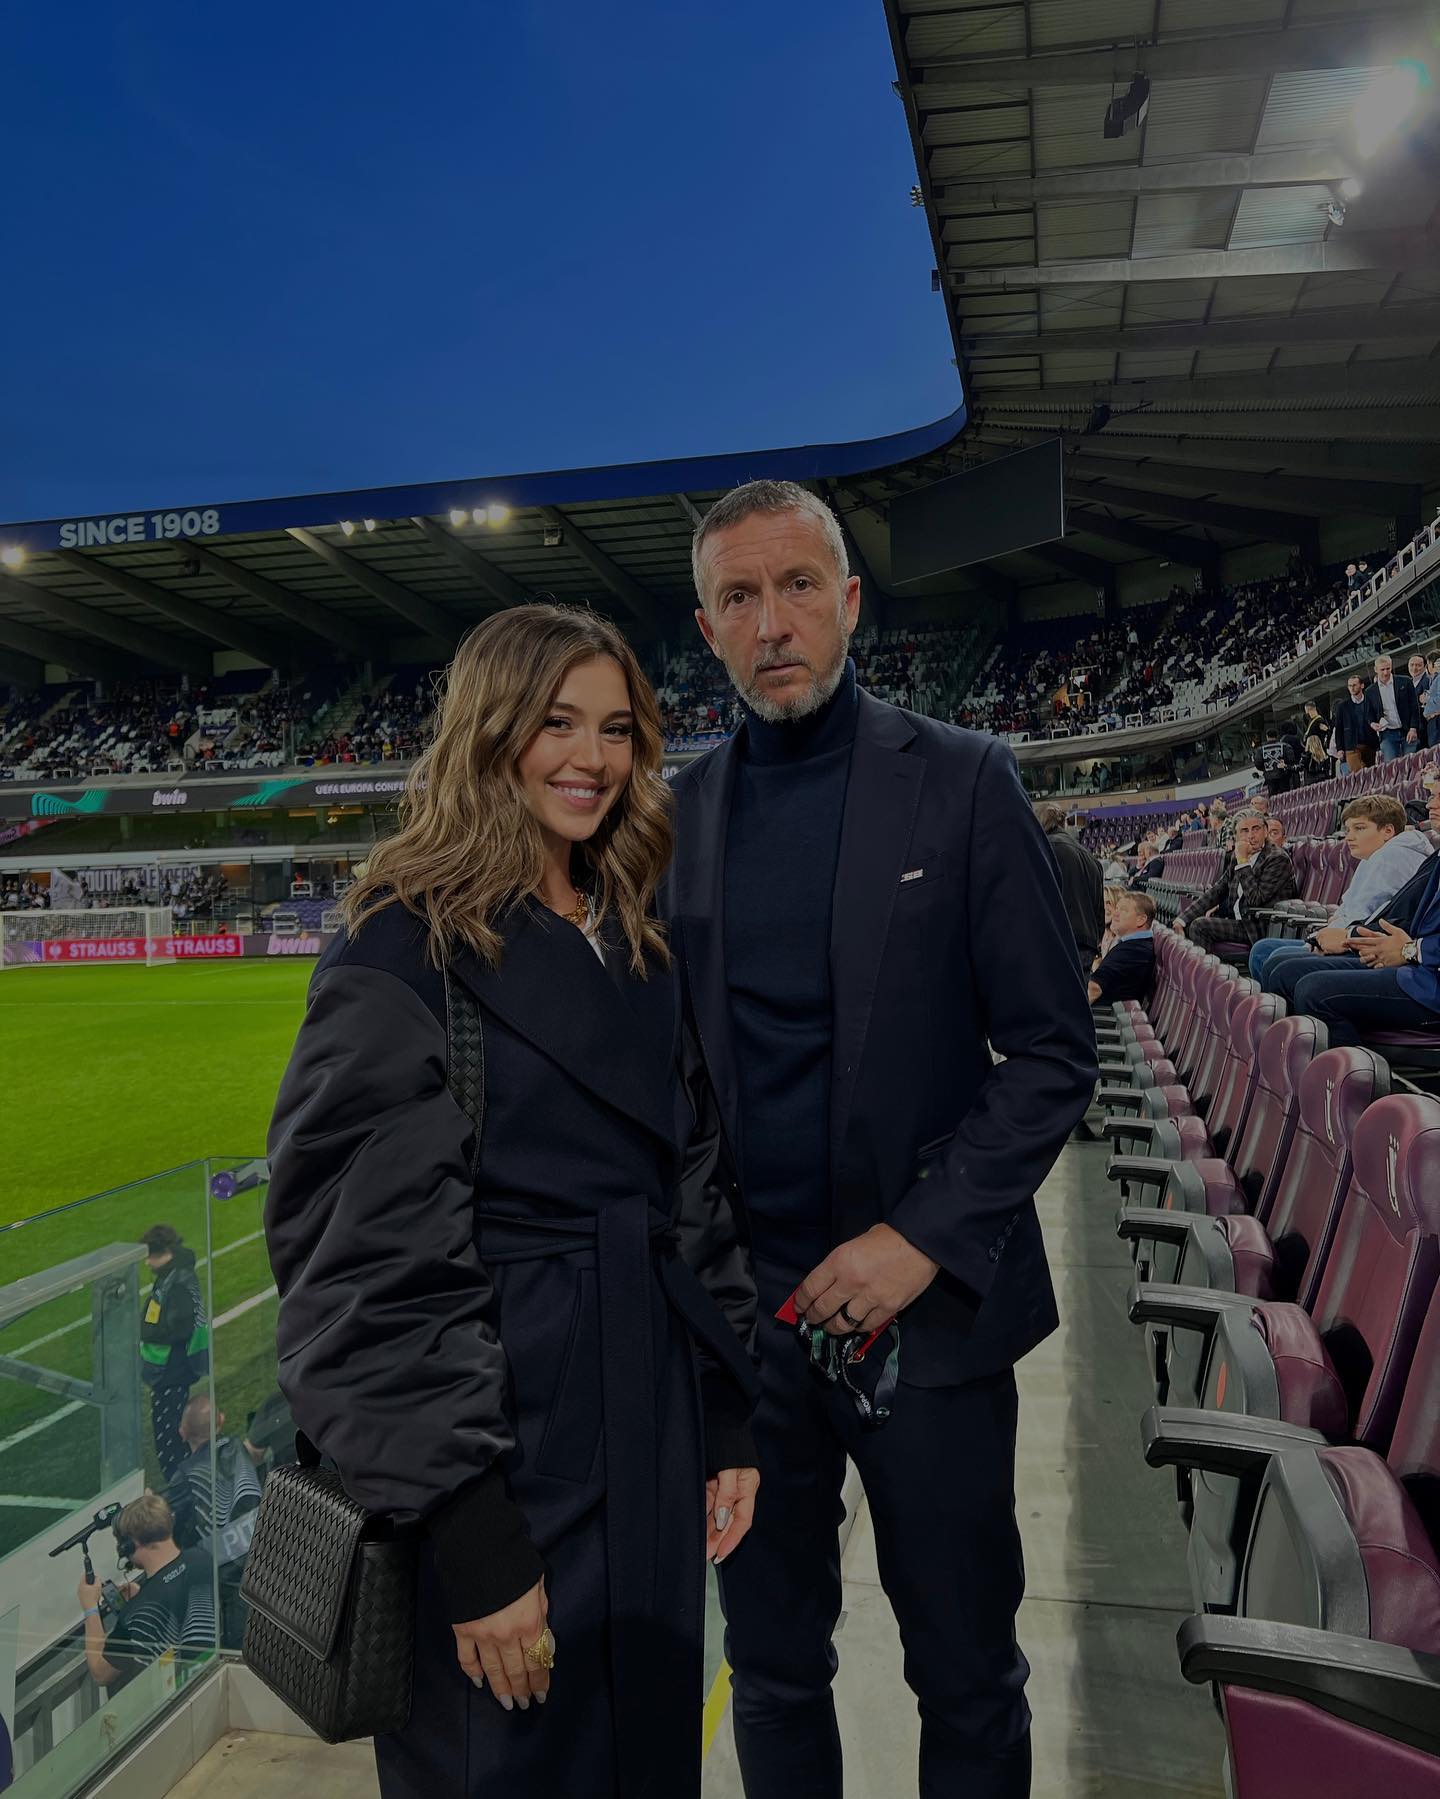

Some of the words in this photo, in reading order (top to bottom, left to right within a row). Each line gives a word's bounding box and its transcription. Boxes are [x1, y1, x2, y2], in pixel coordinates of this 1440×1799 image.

[59, 516, 145, 548] SINCE
[151, 509, 220, 539] 1908
[315, 784, 339, 795] UEFA
[340, 782, 374, 794] EUROPA
[152, 789, 188, 806] bwin
[69, 942, 136, 958] STRAUSS
[165, 938, 237, 954] STRAUSS
